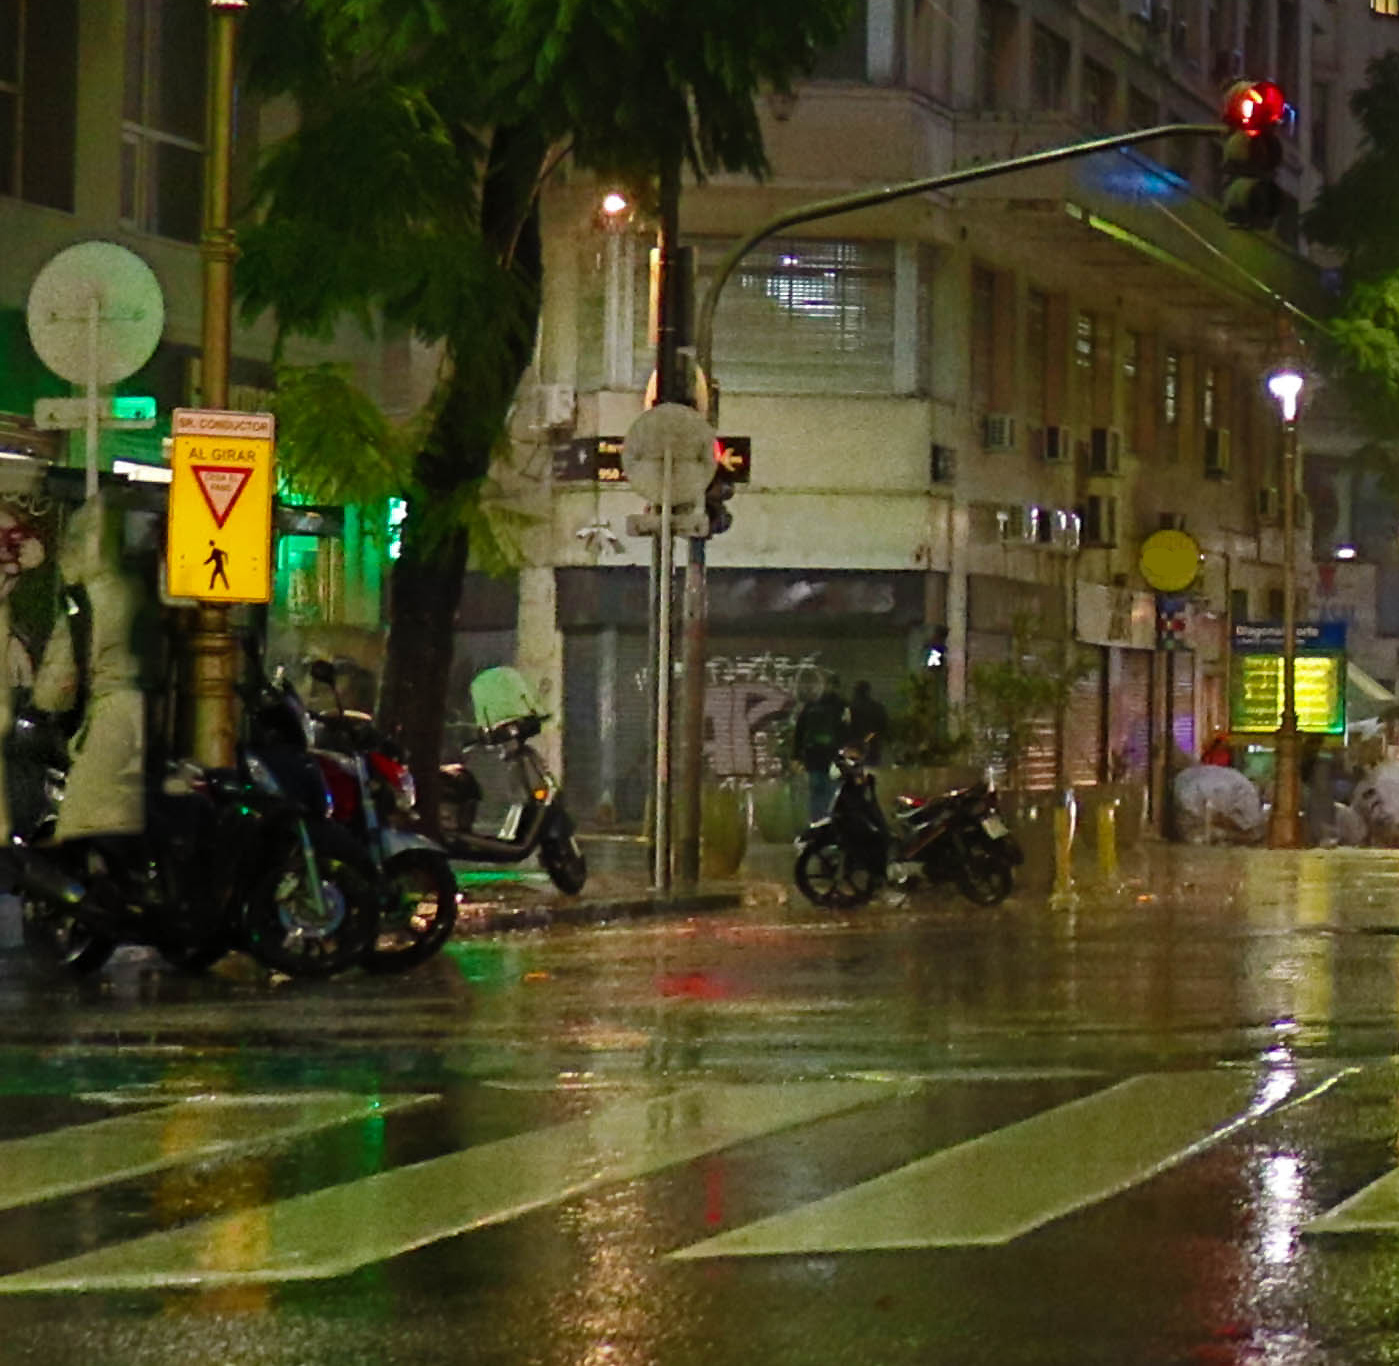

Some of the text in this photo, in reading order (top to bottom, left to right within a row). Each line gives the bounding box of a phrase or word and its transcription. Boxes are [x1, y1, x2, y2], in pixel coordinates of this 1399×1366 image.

[200, 419, 268, 431] CONDUCTOR
[188, 447, 256, 462] AL GIRAR
